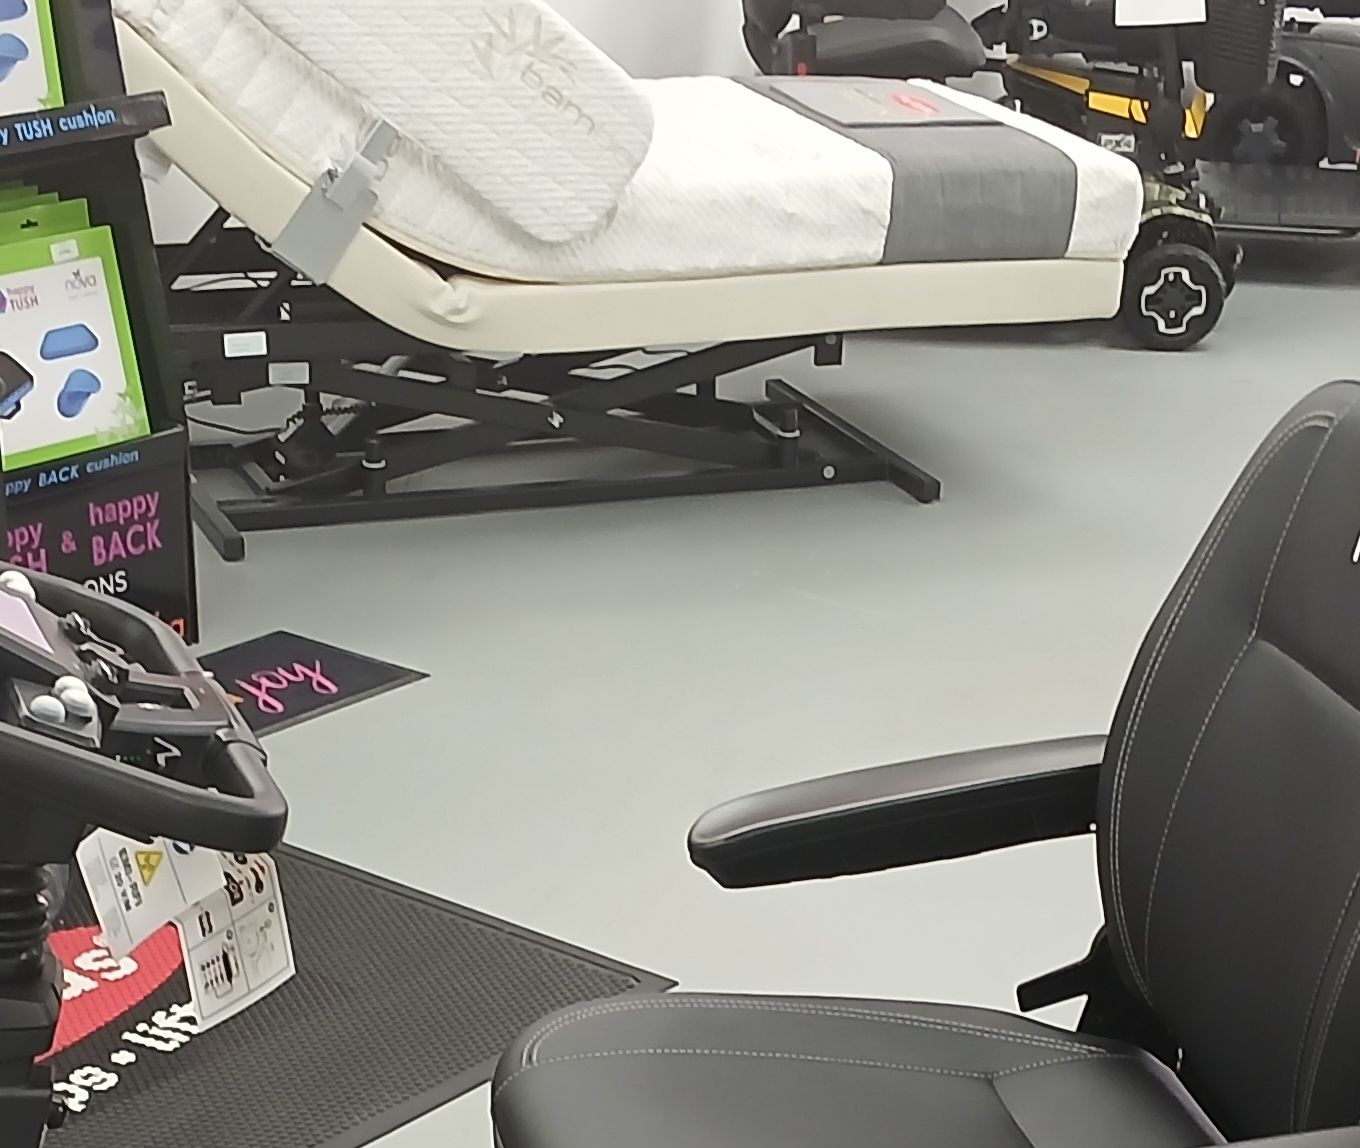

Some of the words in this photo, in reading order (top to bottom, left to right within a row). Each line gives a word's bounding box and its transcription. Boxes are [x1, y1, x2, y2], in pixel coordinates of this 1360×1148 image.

[14, 119, 54, 141] TUSH
[58, 103, 117, 132] cushion
[9, 296, 39, 312] TUSH
[5, 477, 32, 497] ppy
[39, 464, 80, 488] BACK
[86, 449, 139, 474] cushion
[89, 491, 160, 527] happy
[61, 530, 77, 554] &
[92, 519, 163, 566] BACK
[84, 569, 128, 595] ONS
